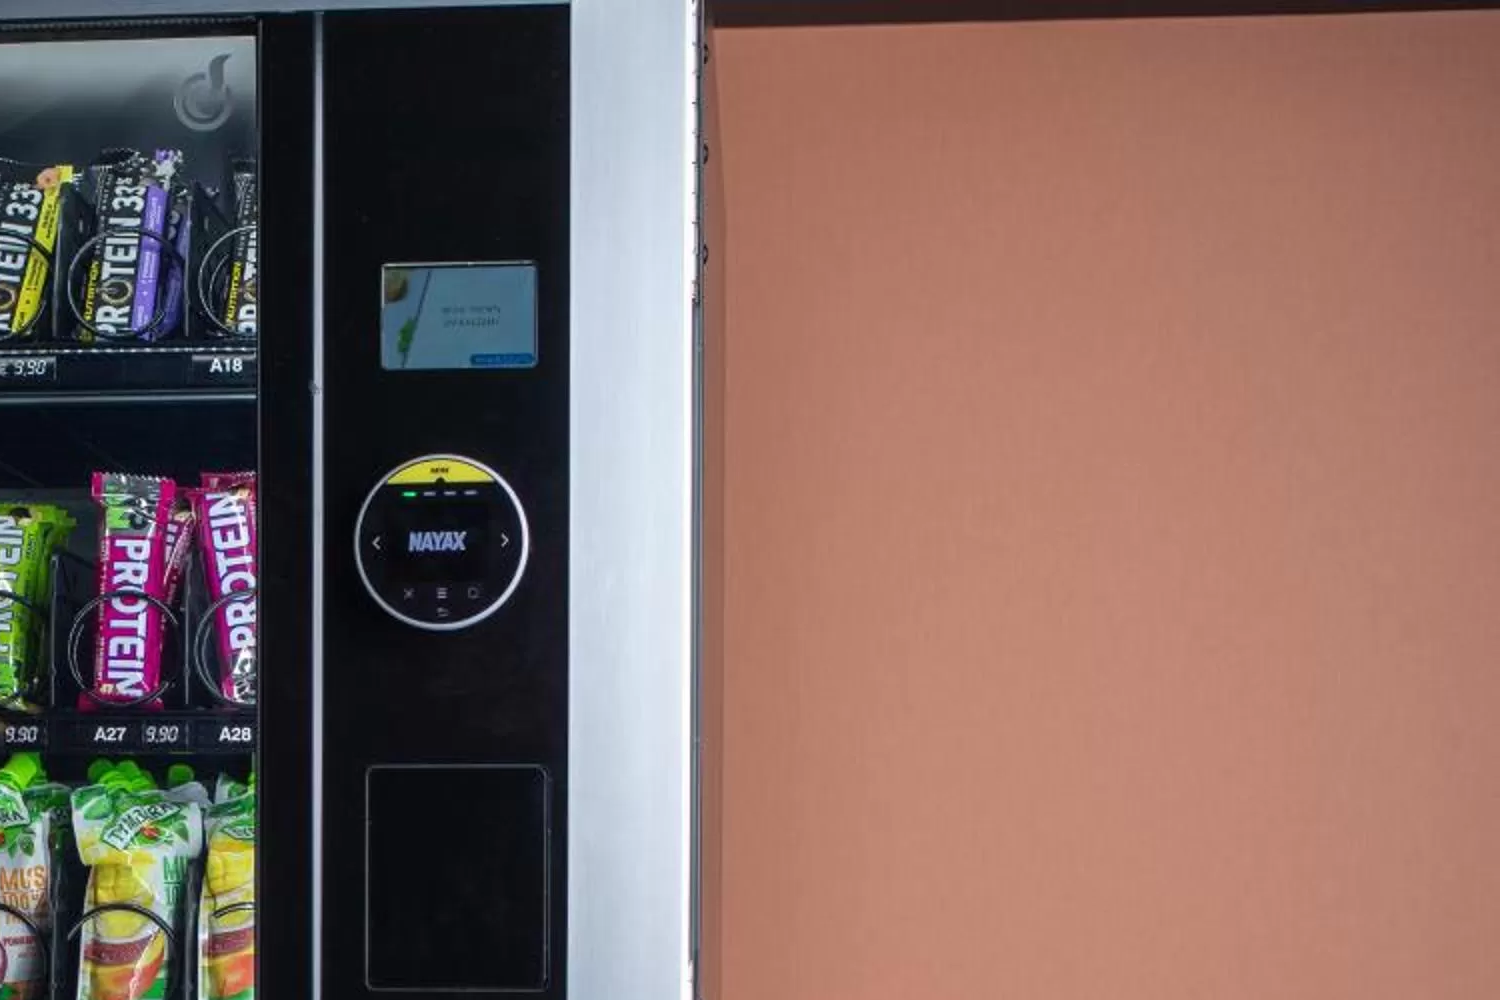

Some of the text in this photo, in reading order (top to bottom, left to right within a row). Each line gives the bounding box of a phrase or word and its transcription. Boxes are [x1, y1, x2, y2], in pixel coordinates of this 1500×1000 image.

[209, 358, 243, 373] A18
[408, 531, 467, 552] NAYAX
[106, 538, 151, 697] PROTEIN
[94, 727, 126, 741] A27
[219, 727, 252, 741] A28
